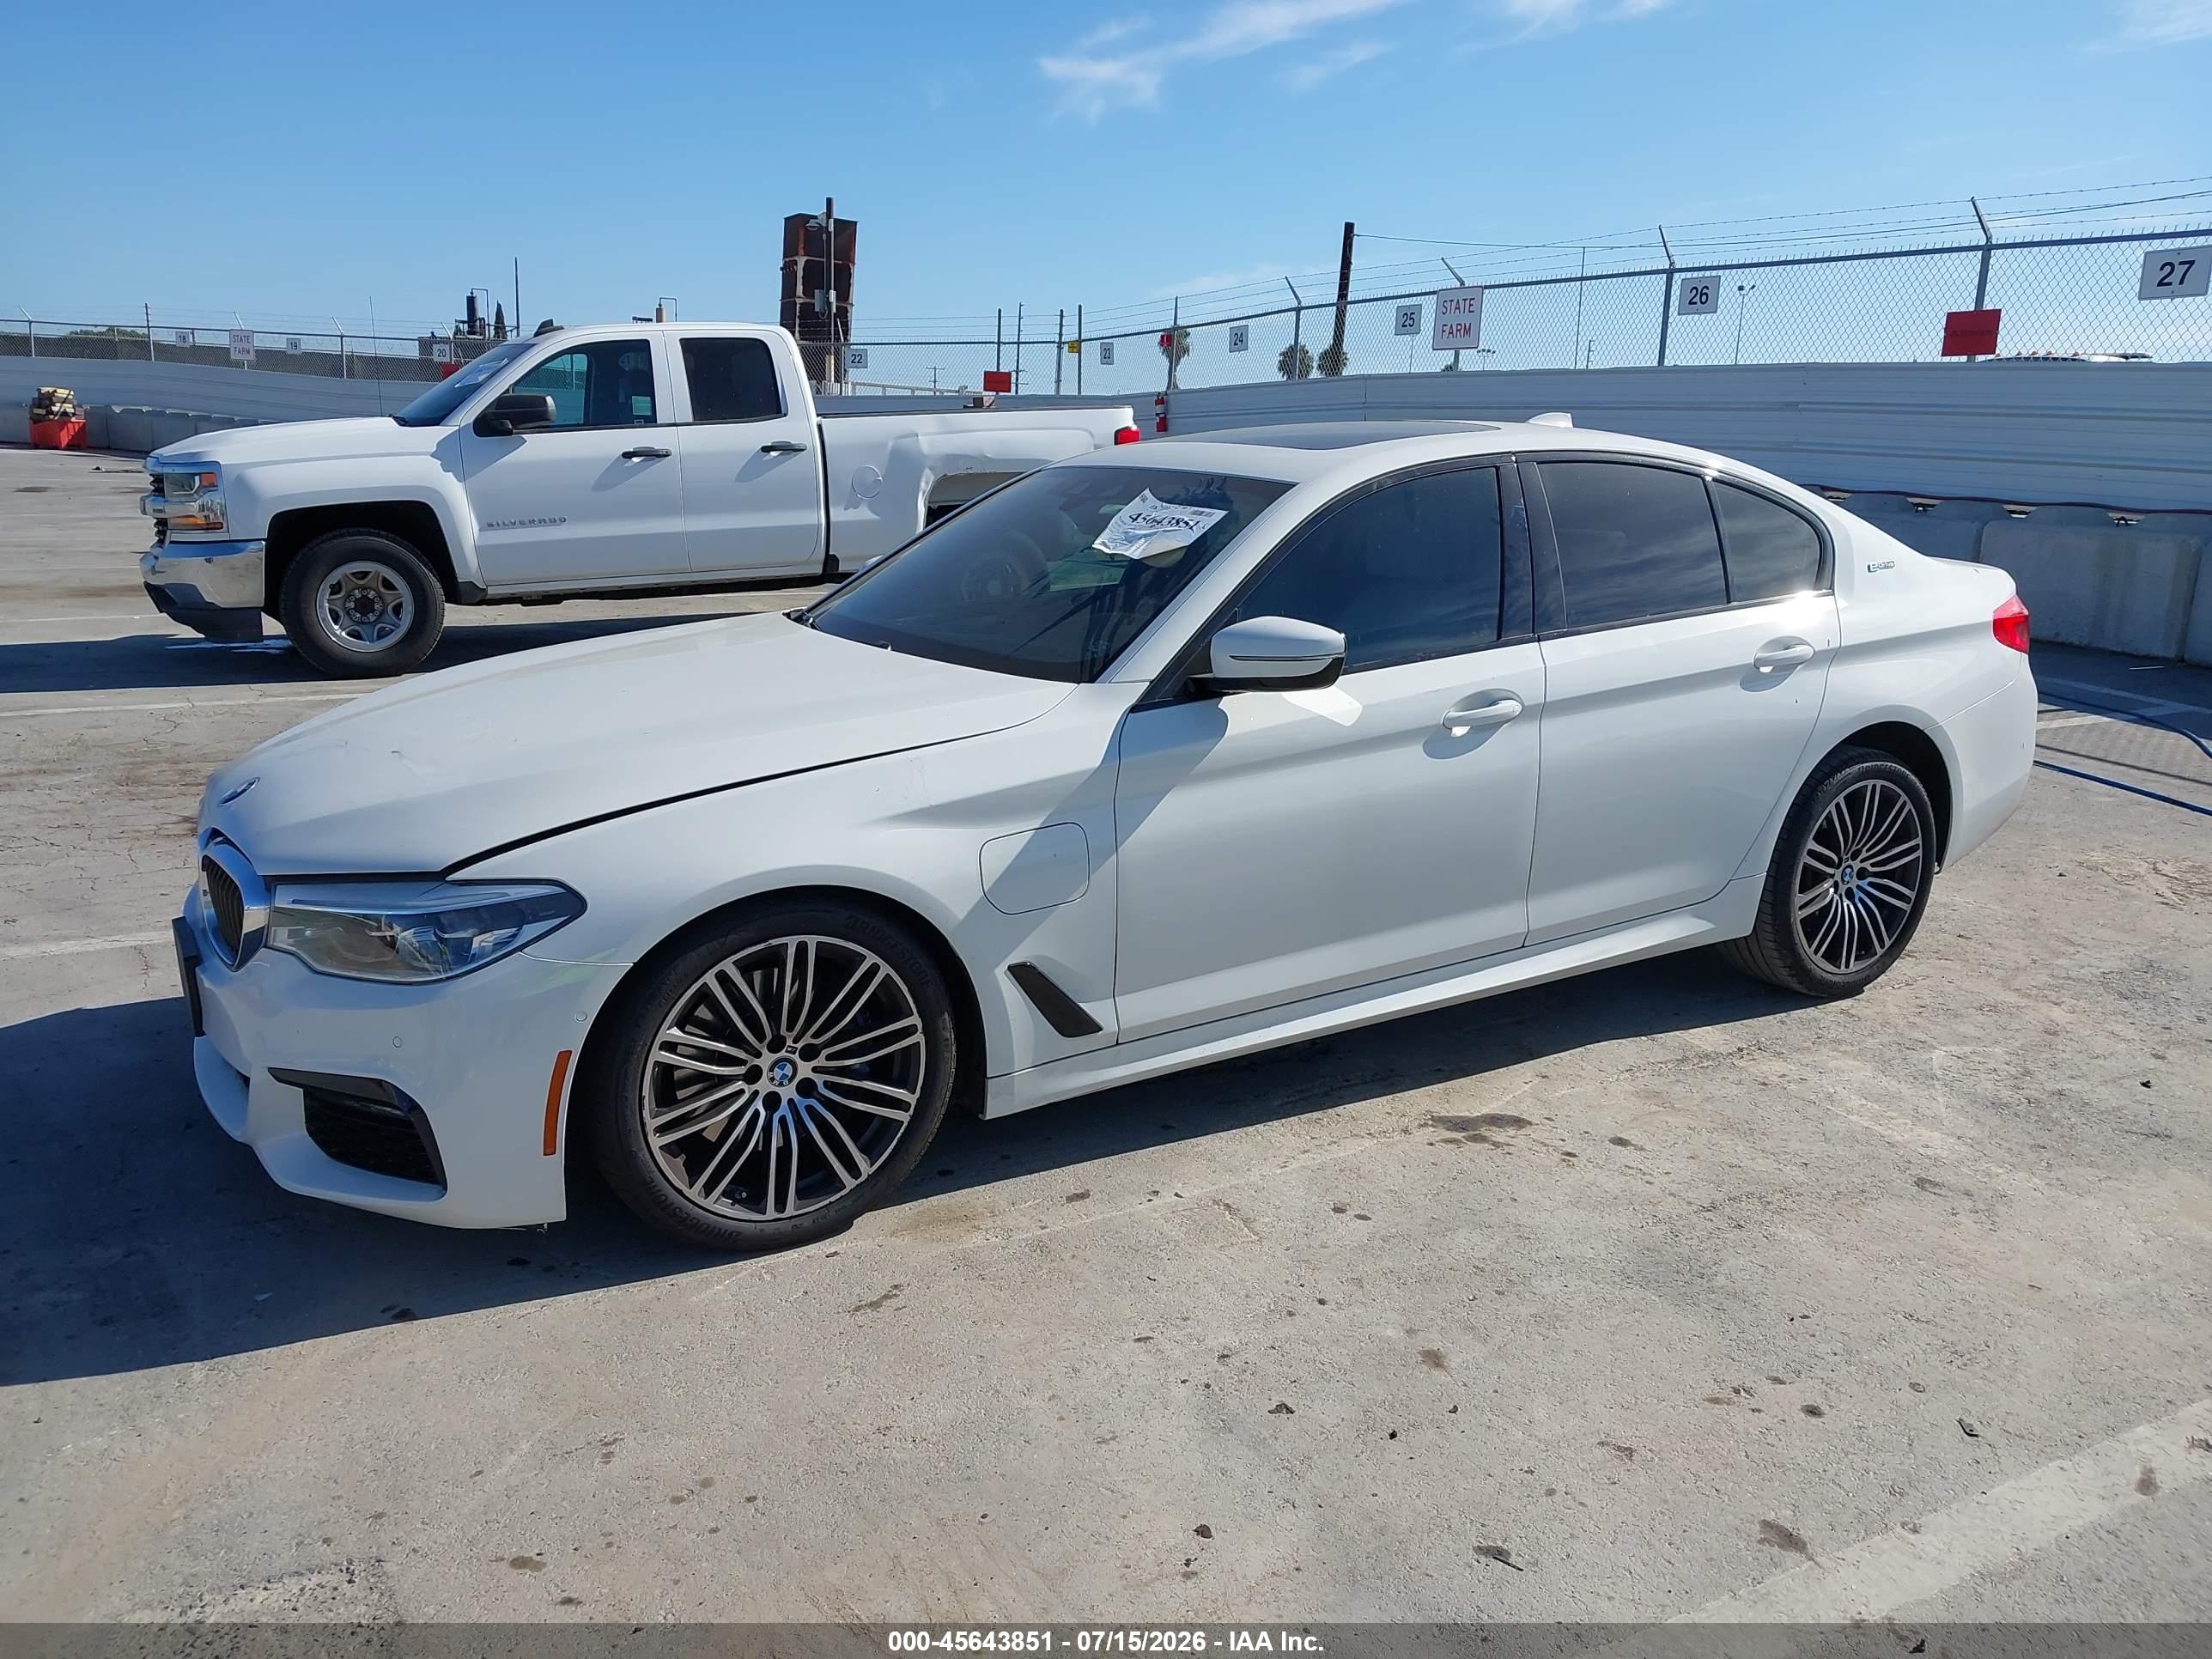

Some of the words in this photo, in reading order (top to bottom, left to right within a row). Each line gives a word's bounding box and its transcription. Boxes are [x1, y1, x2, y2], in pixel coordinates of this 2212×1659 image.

[2157, 259, 2196, 287] 27
[1688, 285, 1710, 305] 26
[1442, 297, 1475, 315] STATE
[1401, 312, 1415, 327] 25
[1441, 322, 1472, 339] FARM
[179, 335, 186, 343] 18
[233, 334, 251, 343] STATE
[1233, 331, 1243, 345] 24
[234, 346, 251, 356] FARM
[290, 342, 298, 350] 19
[437, 349, 447, 357] 20
[851, 353, 863, 363] 22
[1103, 347, 1111, 359] 23
[486, 516, 567, 528] SILVERADO
[1128, 513, 1201, 530] 45643851
